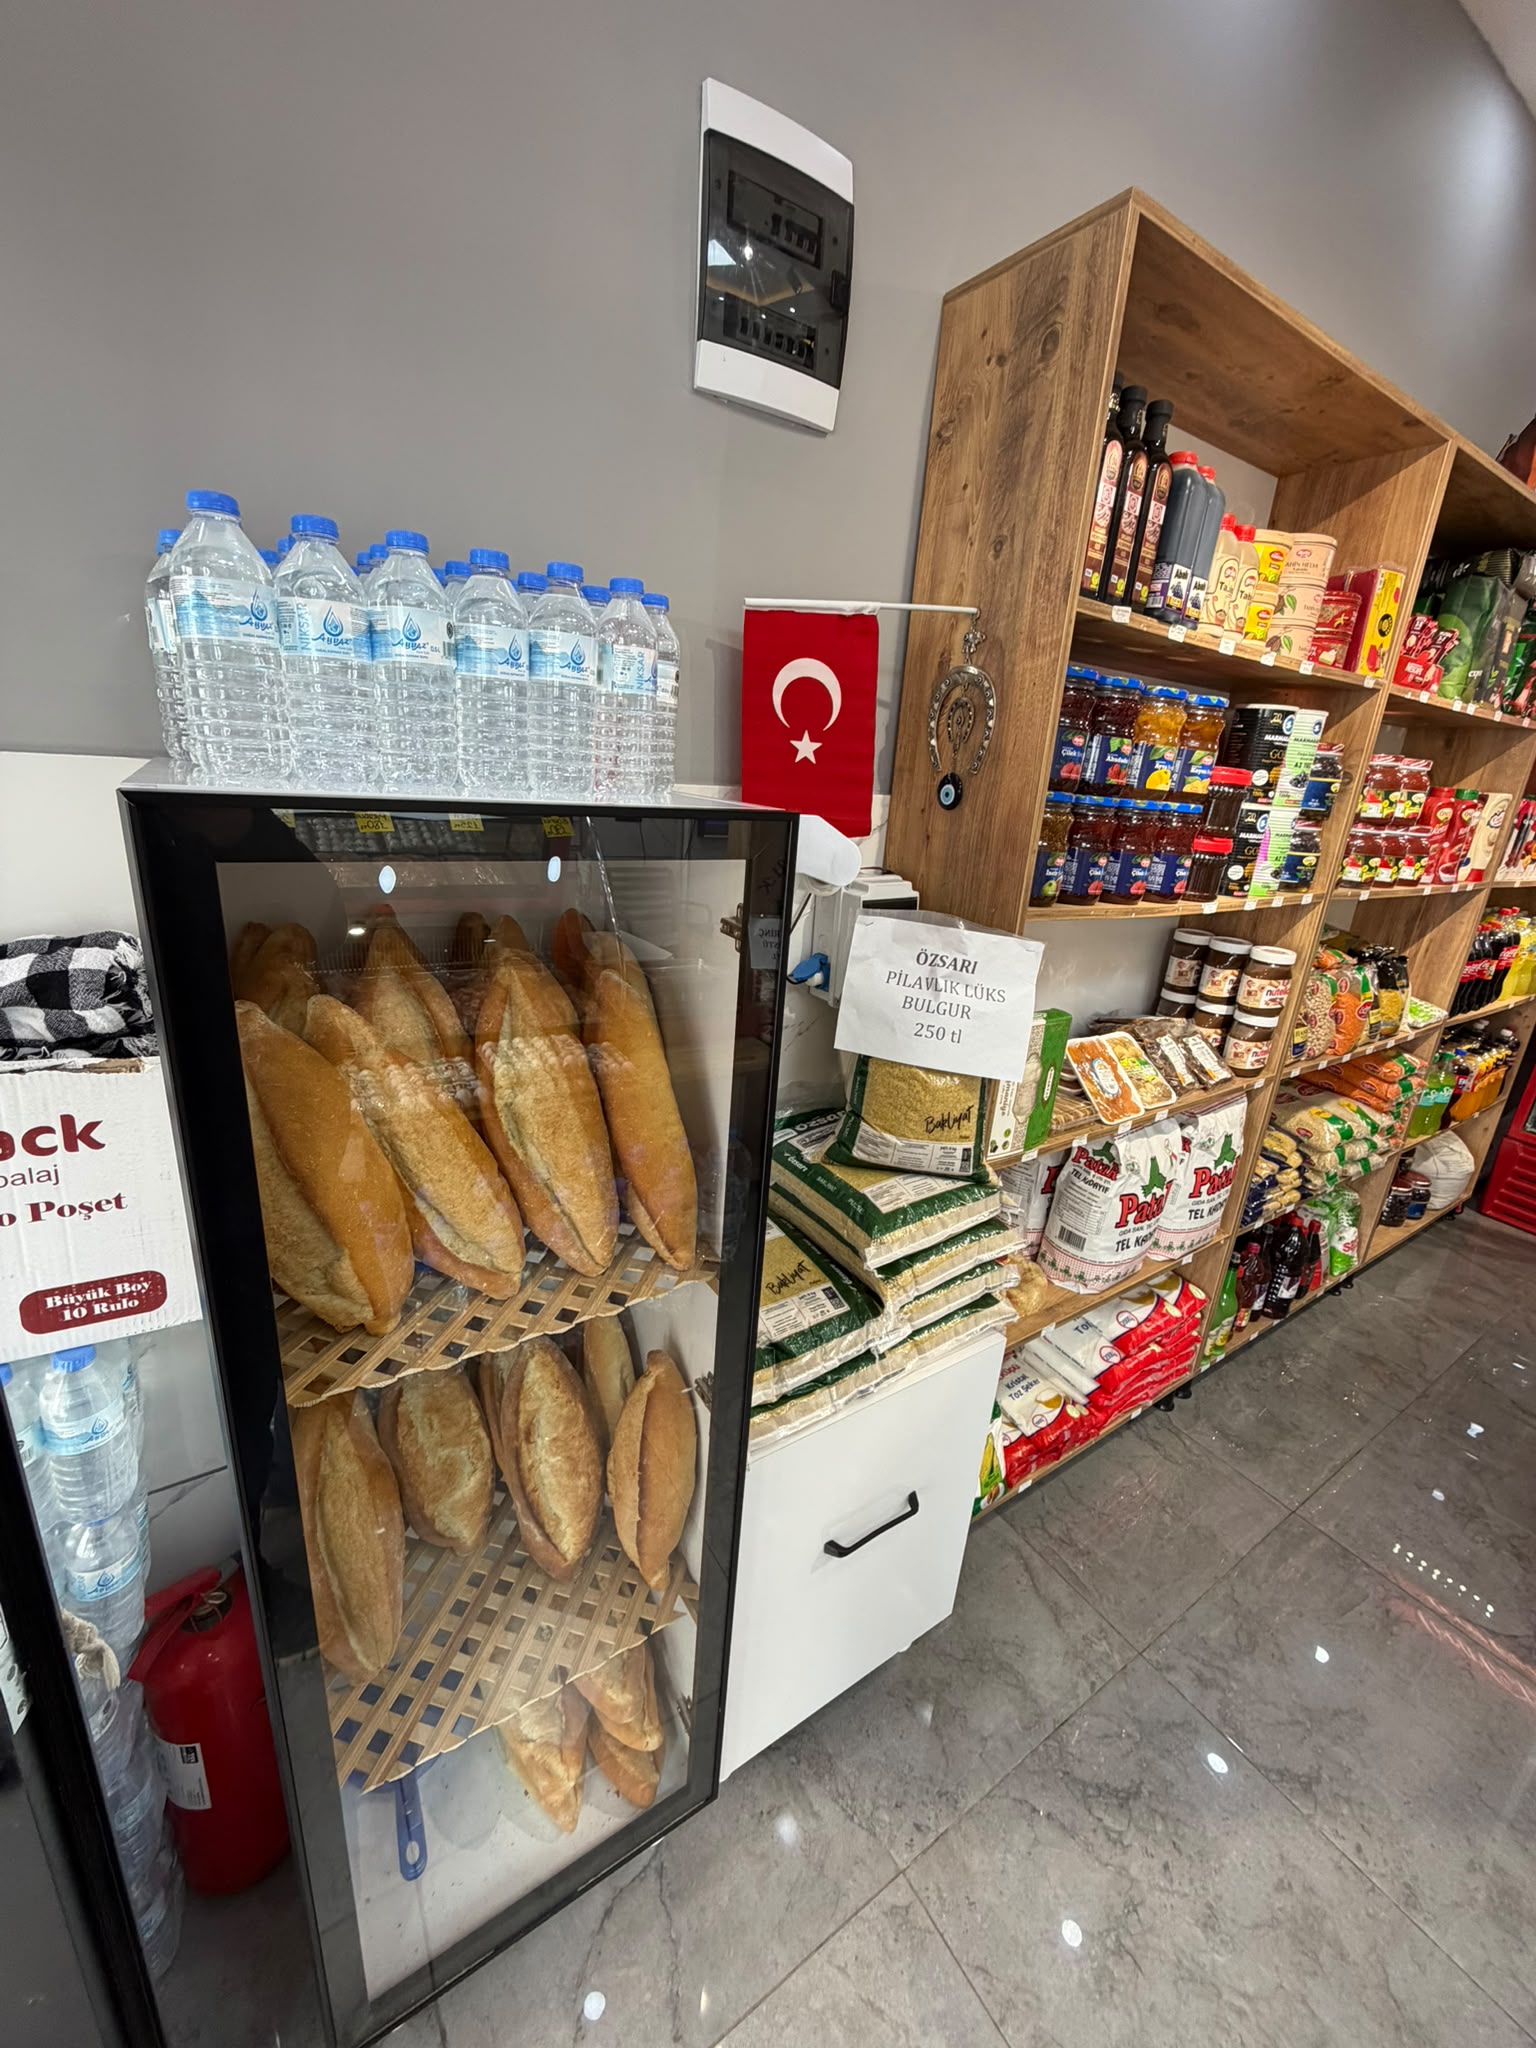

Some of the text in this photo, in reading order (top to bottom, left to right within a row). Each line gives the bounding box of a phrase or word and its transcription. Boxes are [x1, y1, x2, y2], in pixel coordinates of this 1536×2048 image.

[915, 948, 979, 975] ÖZSARI
[885, 970, 1007, 1004] PİLAVLIK LÜKS
[901, 995, 972, 1020] BULGUR
[913, 1022, 946, 1042] 250
[25, 1192, 128, 1224] Poşet
[45, 1279, 152, 1310] Büyük Boy
[61, 1297, 140, 1323] 10 Rulo
